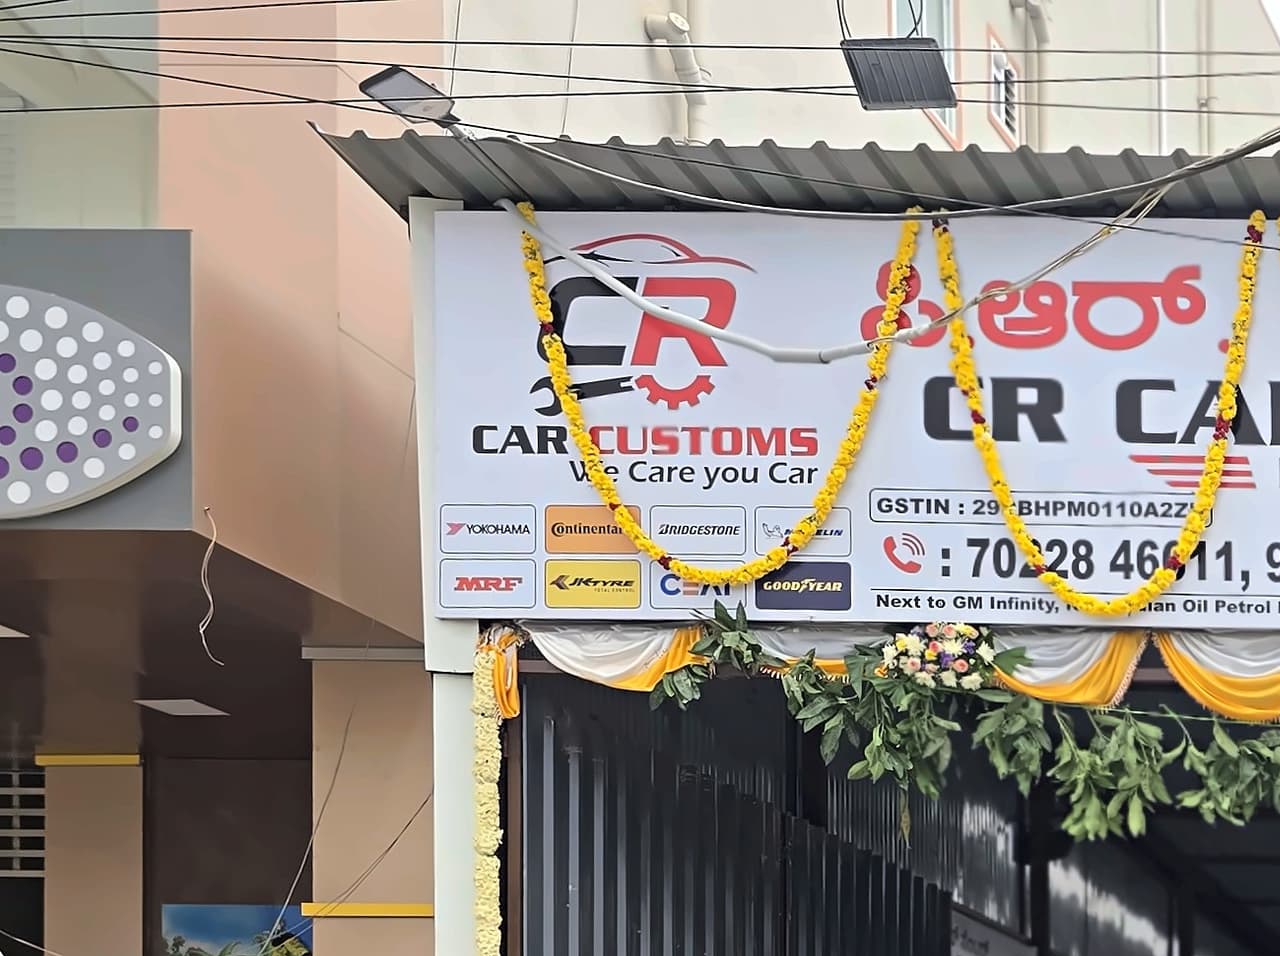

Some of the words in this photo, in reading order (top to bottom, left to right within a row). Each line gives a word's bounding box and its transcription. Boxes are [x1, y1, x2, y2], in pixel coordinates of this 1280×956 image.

[922, 377, 1069, 442] CR
[472, 425, 568, 454] CAR
[589, 426, 818, 456] CUSTOMS
[628, 461, 696, 484] Care
[702, 465, 758, 490] you
[768, 462, 818, 484] Car
[877, 498, 950, 515] GSTIN
[466, 524, 530, 535] YOKOHAMA
[657, 524, 740, 536] BRIDGESTONE
[454, 577, 523, 591] MRF
[876, 594, 926, 609] Next
[928, 596, 945, 609] to
[952, 595, 983, 610] GM
[989, 596, 1059, 613] Infinity,
[1182, 599, 1207, 613] Oil
[1215, 599, 1271, 615] Petrol
